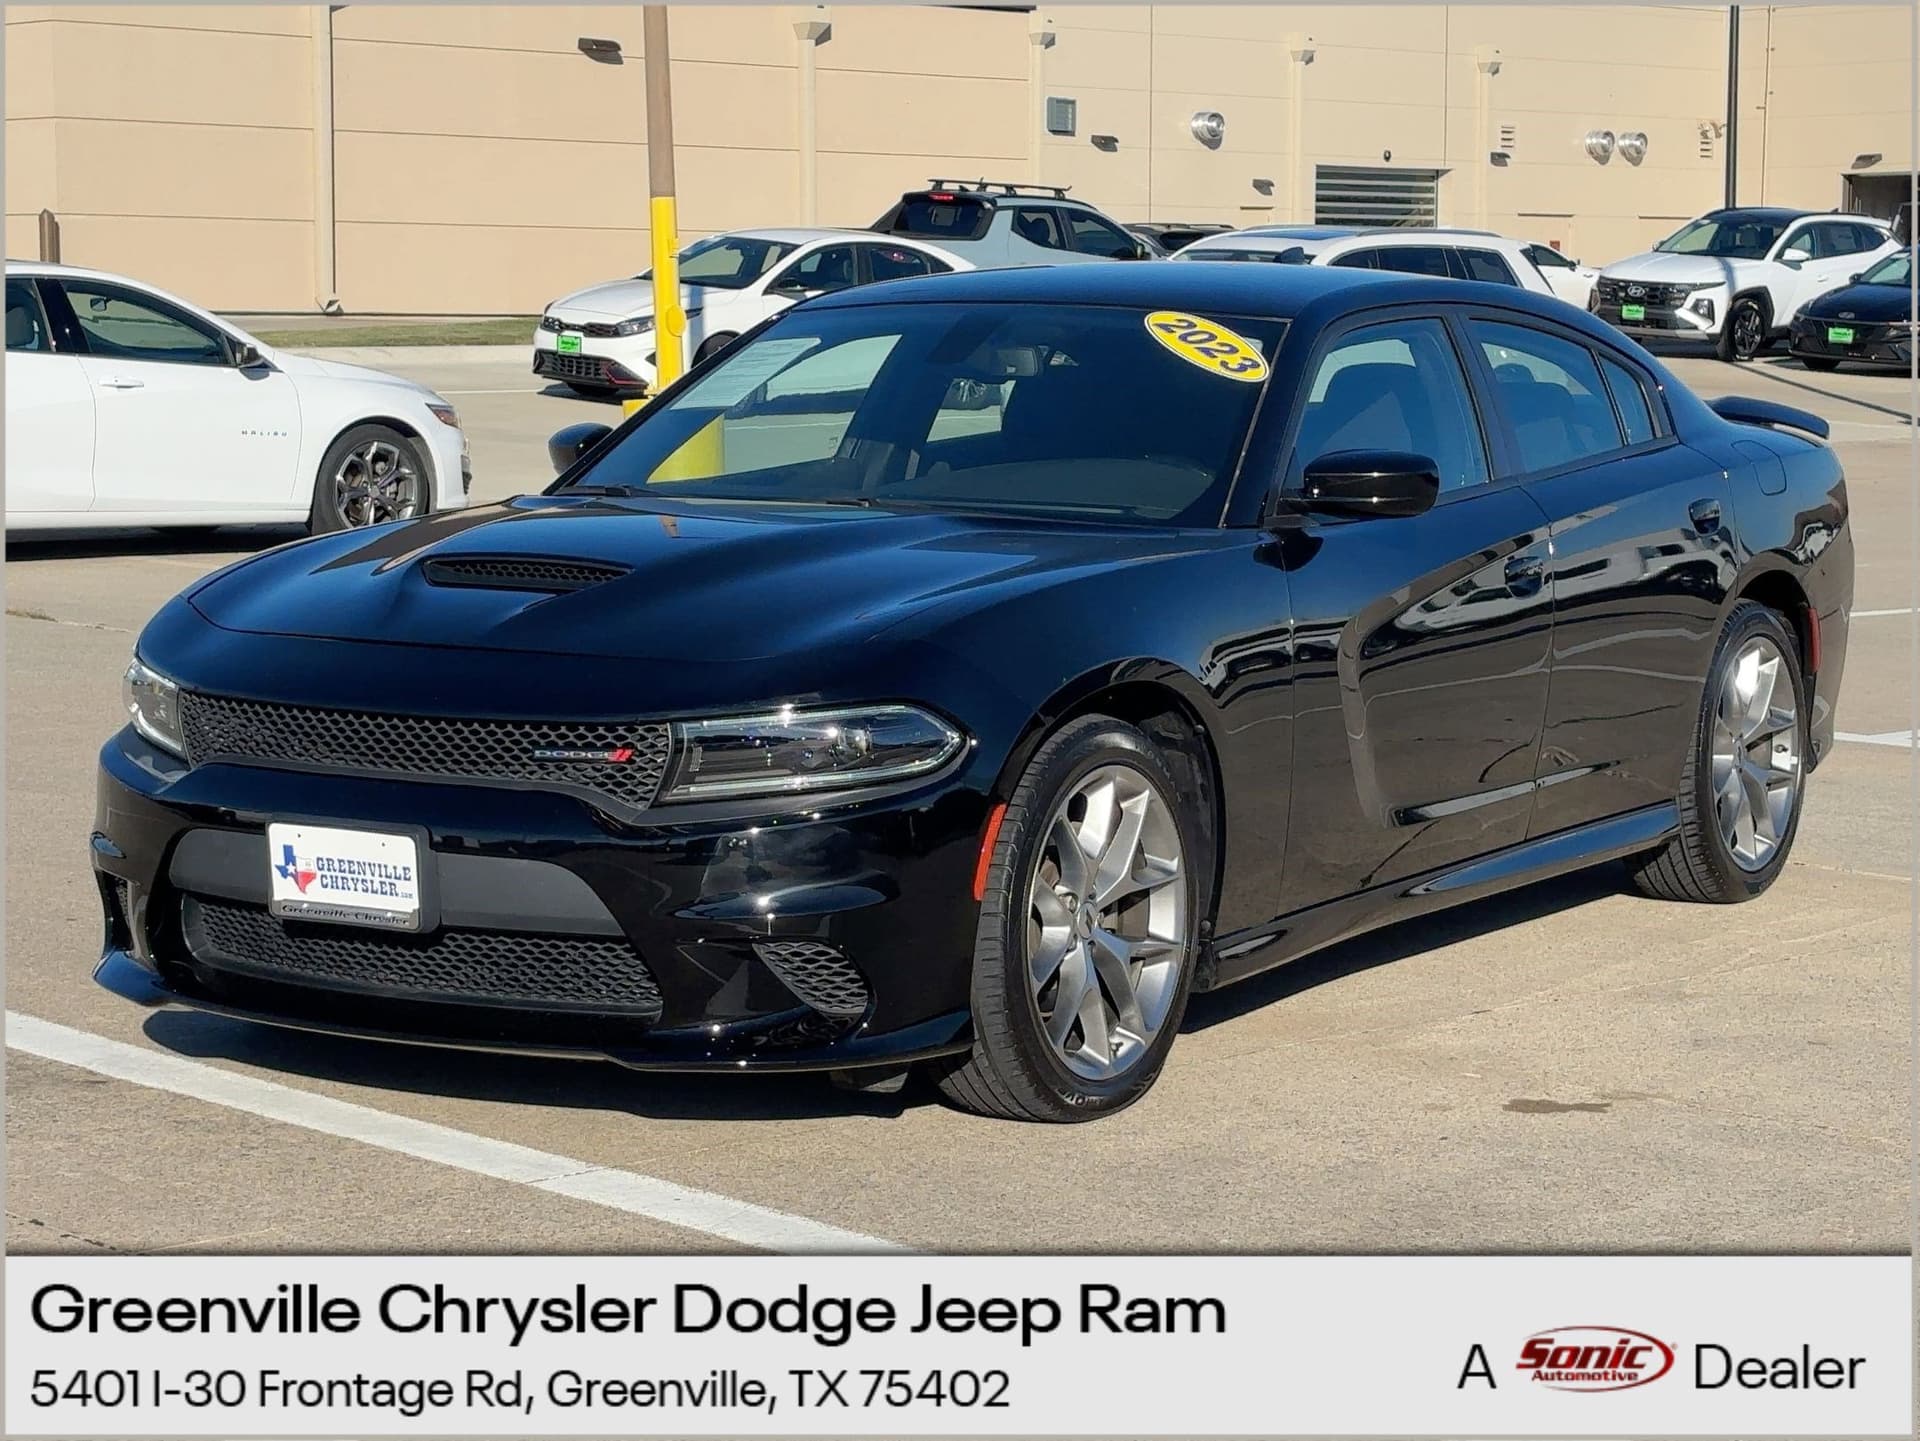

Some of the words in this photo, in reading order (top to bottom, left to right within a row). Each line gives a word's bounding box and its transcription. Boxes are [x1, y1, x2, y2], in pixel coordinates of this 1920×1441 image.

[1152, 318, 1261, 373] 2023
[316, 856, 412, 882] GREENVILLE
[320, 874, 400, 898] CHRYSLER
[282, 904, 351, 920] Greenville
[354, 912, 410, 926] Chrysler
